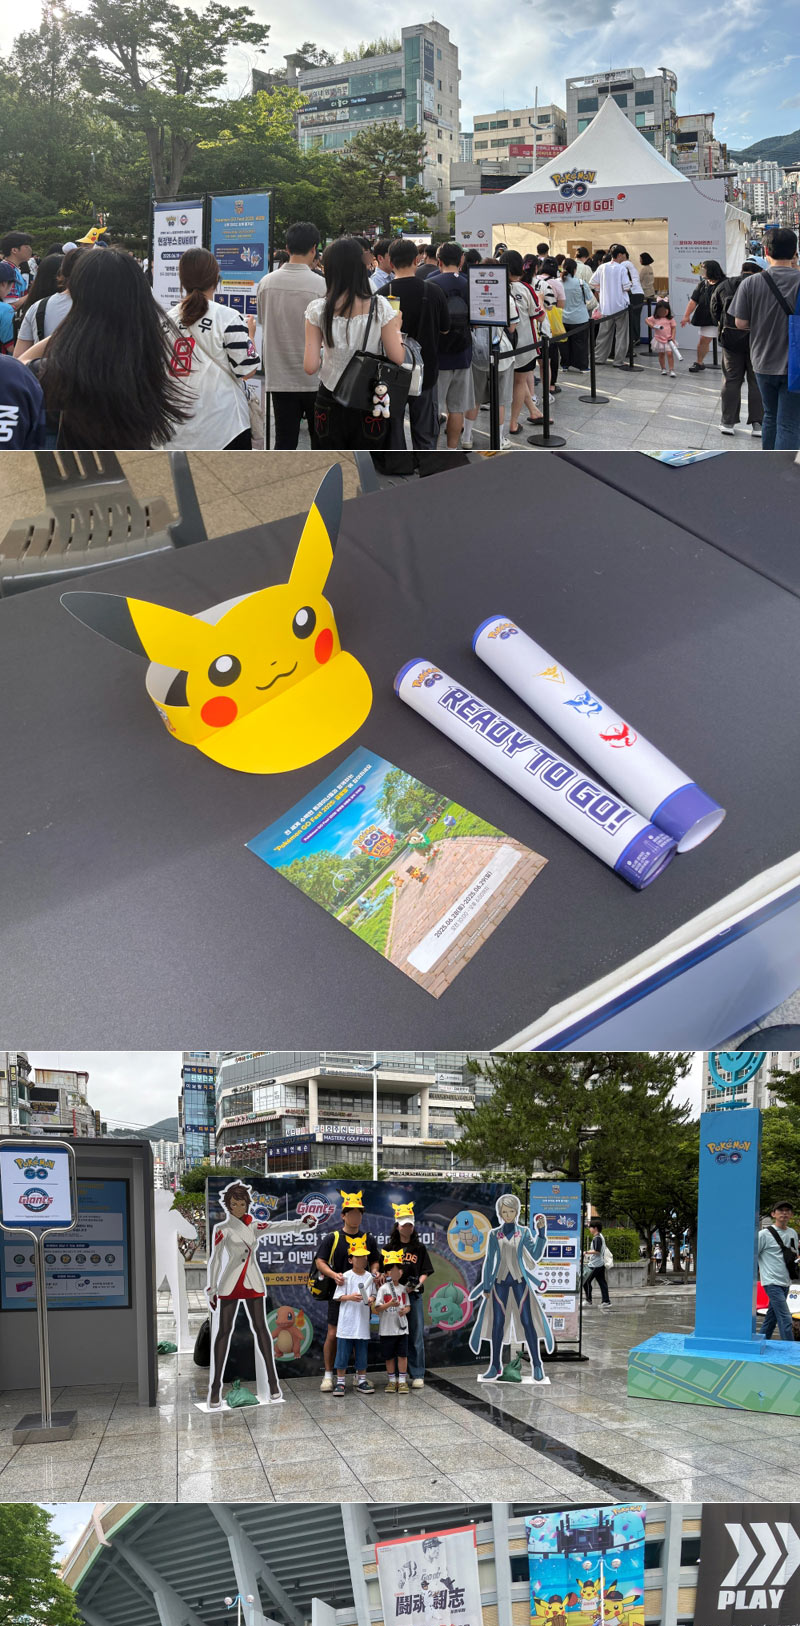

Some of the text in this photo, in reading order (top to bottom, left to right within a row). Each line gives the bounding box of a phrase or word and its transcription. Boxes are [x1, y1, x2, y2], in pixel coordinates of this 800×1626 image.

[558, 182, 589, 198] GO
[534, 198, 614, 214] READY TO GO!
[168, 337, 196, 377] 8
[487, 623, 518, 640] Pokémon
[499, 627, 518, 640] GO
[411, 666, 441, 689] Pokémon
[424, 672, 443, 688] GO
[437, 685, 637, 836] READY TO GO!
[705, 1139, 751, 1154] Pokémon
[14, 1156, 55, 1170] Pokémon
[715, 1152, 742, 1164] GO
[24, 1168, 49, 1180] GO
[18, 1195, 54, 1205] Giants
[296, 1202, 336, 1215] Giants
[259, 1251, 285, 1265] 리그
[717, 1589, 785, 1610] PLAY
